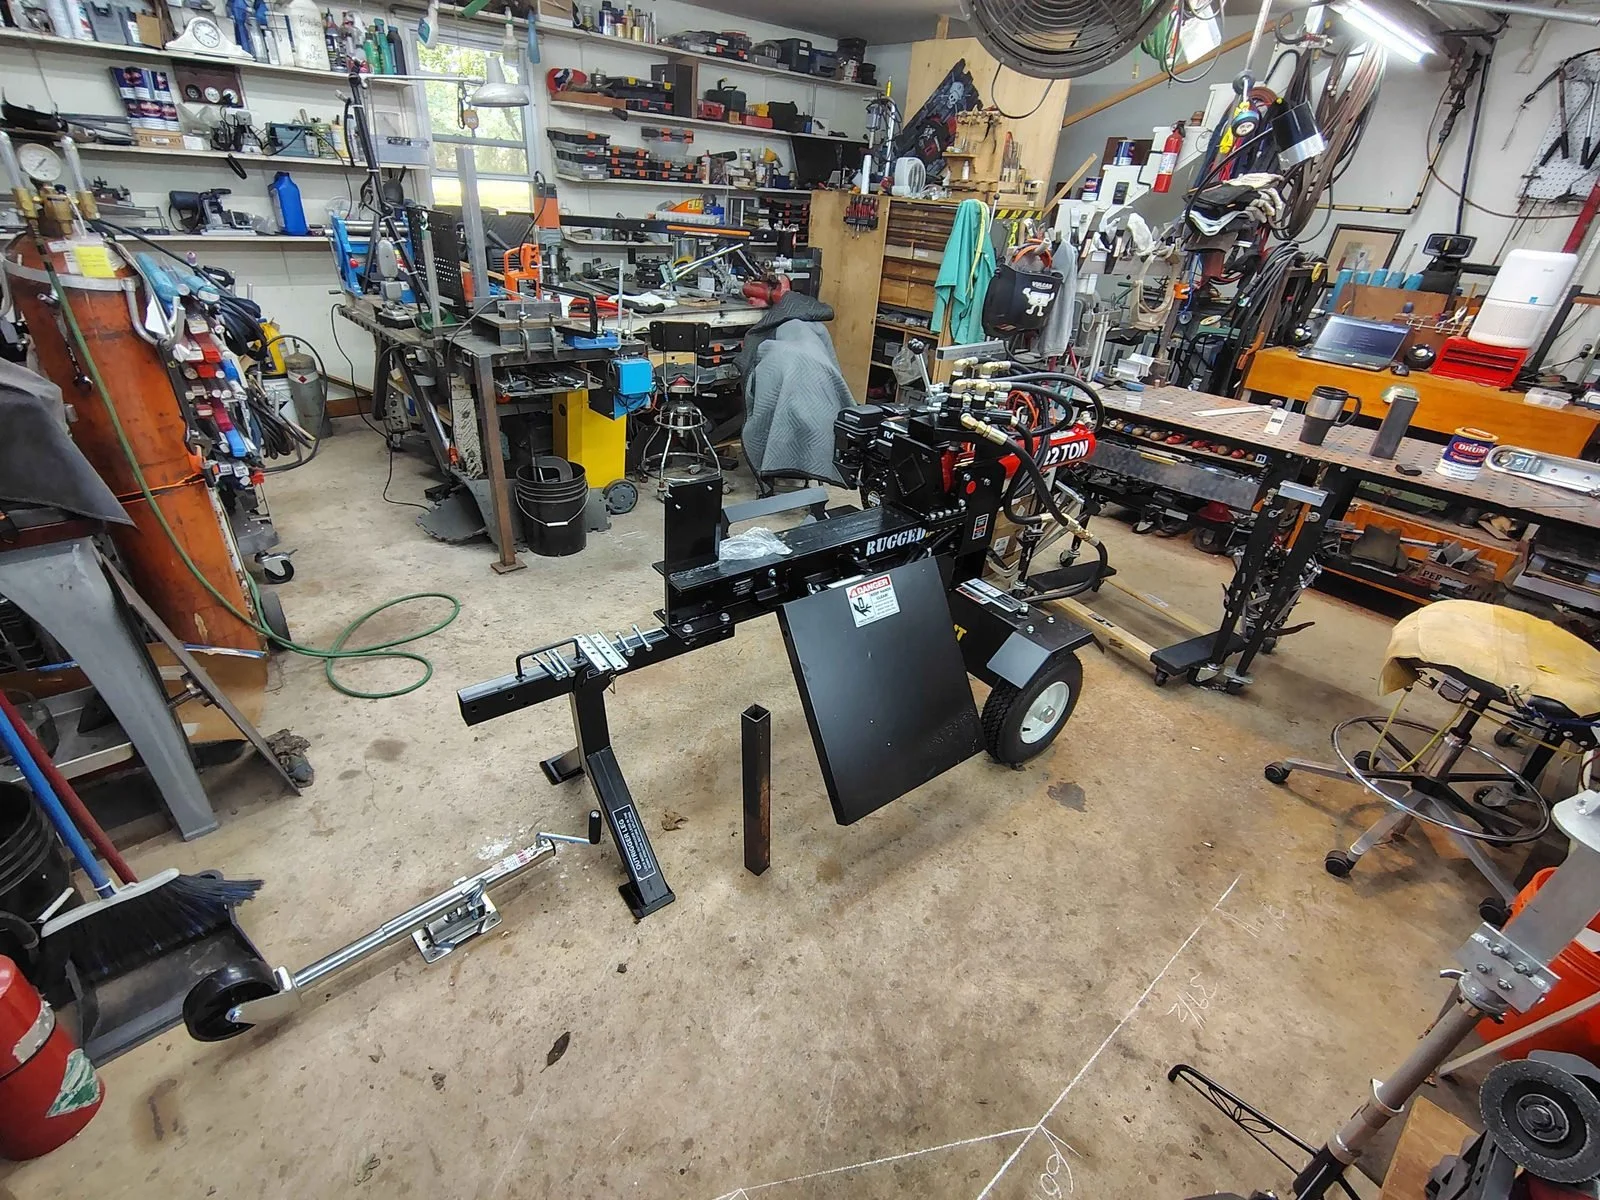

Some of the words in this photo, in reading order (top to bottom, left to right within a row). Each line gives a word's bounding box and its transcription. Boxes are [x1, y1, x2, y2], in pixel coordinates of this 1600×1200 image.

[1060, 440, 1089, 462] TON
[1458, 444, 1486, 454] DRUM
[866, 527, 926, 556] RUGGED
[856, 578, 888, 594] DANGER
[618, 818, 628, 833] LEG
[623, 833, 642, 870] OUTRIGGER
